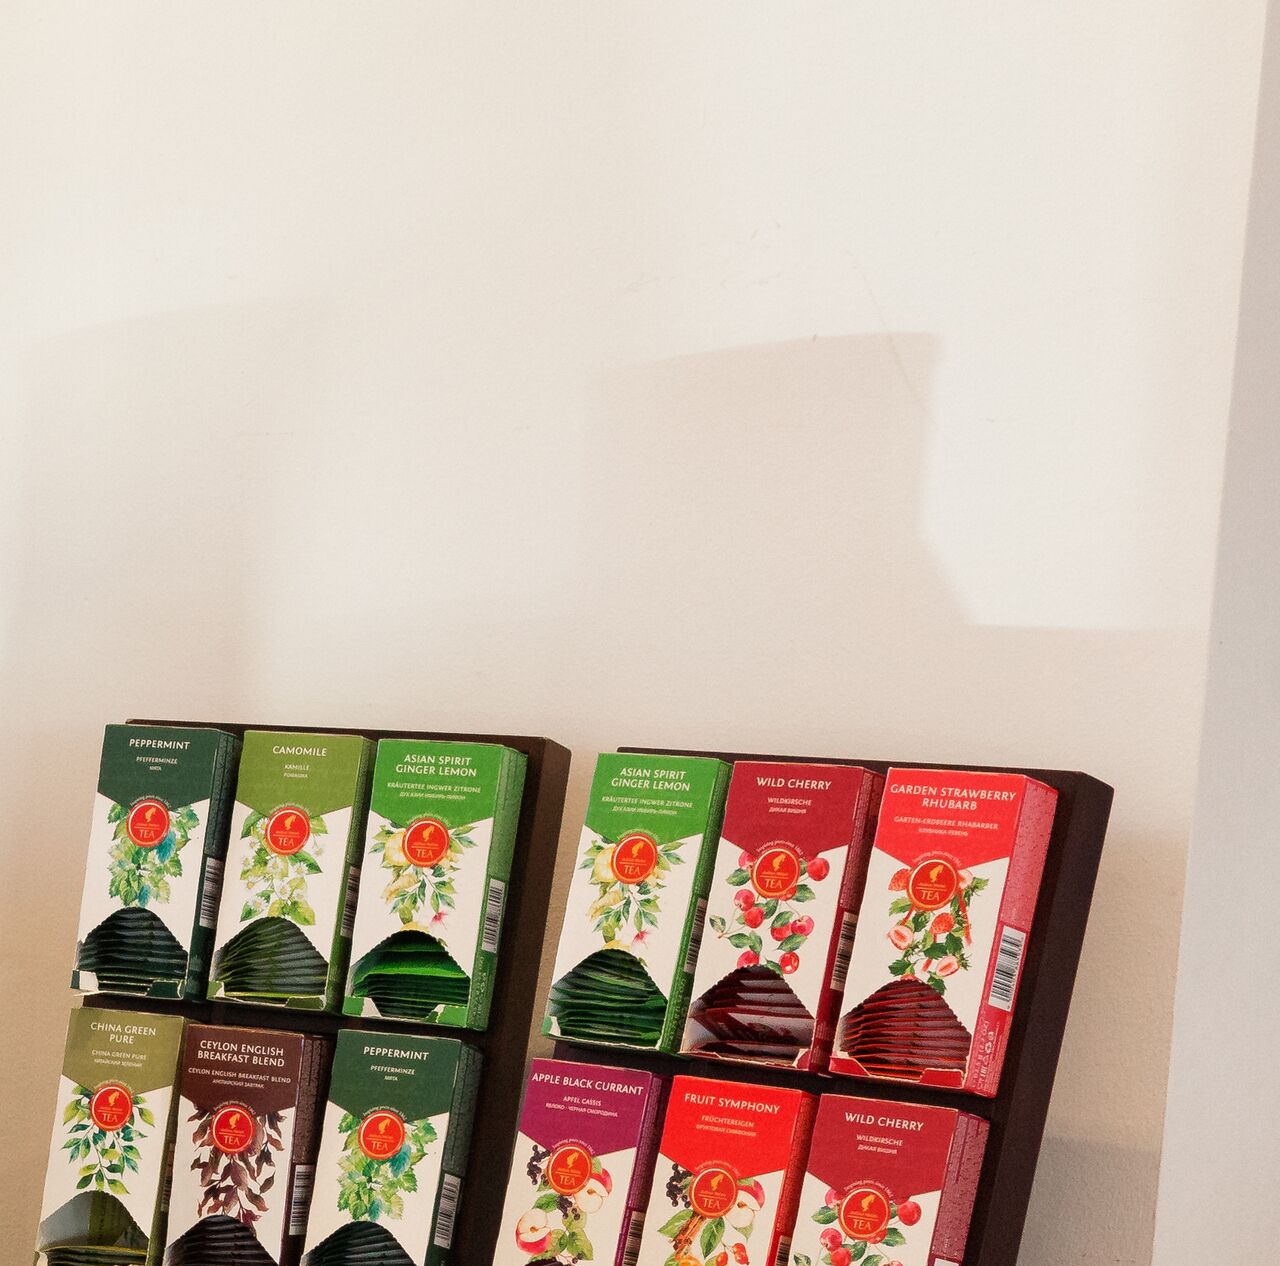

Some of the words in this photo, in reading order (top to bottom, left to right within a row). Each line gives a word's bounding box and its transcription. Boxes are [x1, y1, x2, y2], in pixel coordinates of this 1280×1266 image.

[129, 739, 189, 750] PEPPERMINT
[273, 746, 327, 757] CAMOMILE
[404, 755, 435, 763] ASIAN
[439, 756, 472, 766] SPIRIT
[396, 765, 435, 774] GINGER
[439, 766, 476, 776] LEMON
[620, 768, 650, 777] ASIAN
[654, 769, 686, 780] SPIRIT
[611, 778, 650, 789] GINGER
[653, 780, 690, 791] LEMON
[757, 777, 785, 788] WILD
[788, 779, 831, 790] CHERRY
[890, 784, 936, 795] GARDEN
[941, 788, 1016, 801] STRAWBERRY
[640, 798, 665, 807] INGWER
[666, 799, 693, 808] ZITRONE
[768, 797, 811, 806] WILDKIRSCHE
[922, 798, 977, 810] RHUBARB
[958, 820, 998, 829] RHABARBER
[140, 830, 154, 839] TEA
[278, 838, 294, 847] TEA
[415, 849, 433, 857] TEA
[624, 865, 640, 874] TEA
[765, 879, 782, 889] TEA
[921, 890, 940, 900] TEA
[91, 1022, 122, 1033] CHINA
[125, 1025, 156, 1036] GREEN
[110, 1035, 134, 1045] PURE
[200, 1040, 238, 1051] CEYLON
[241, 1044, 283, 1056] ENGLISH
[364, 1047, 429, 1060] PEPPERMINT
[197, 1050, 249, 1064] BREAKFAST
[253, 1056, 284, 1067] BLEND
[188, 1067, 209, 1075] CEYLON
[212, 1070, 236, 1078] ENGLISH
[239, 1072, 269, 1081] BREAKFAST
[370, 1065, 415, 1075] PFEFFERMINZE
[532, 1073, 560, 1085] APPLE
[563, 1077, 592, 1089] BLACK
[595, 1081, 643, 1096] CURRANT
[563, 1096, 580, 1104] APFEL
[582, 1098, 601, 1106] CASSIS
[685, 1093, 715, 1105] FRUIT
[718, 1097, 780, 1114] SYMPHONY
[102, 1113, 117, 1122] TEA
[845, 1112, 874, 1125] WILD
[878, 1117, 924, 1131] CHERRY
[223, 1135, 240, 1145] TEA
[856, 1134, 903, 1146] WILDKIRSCHE
[371, 1141, 388, 1151] TEA
[560, 1176, 576, 1185] TEA
[703, 1199, 721, 1209] TEA
[852, 1219, 872, 1230] TEA
